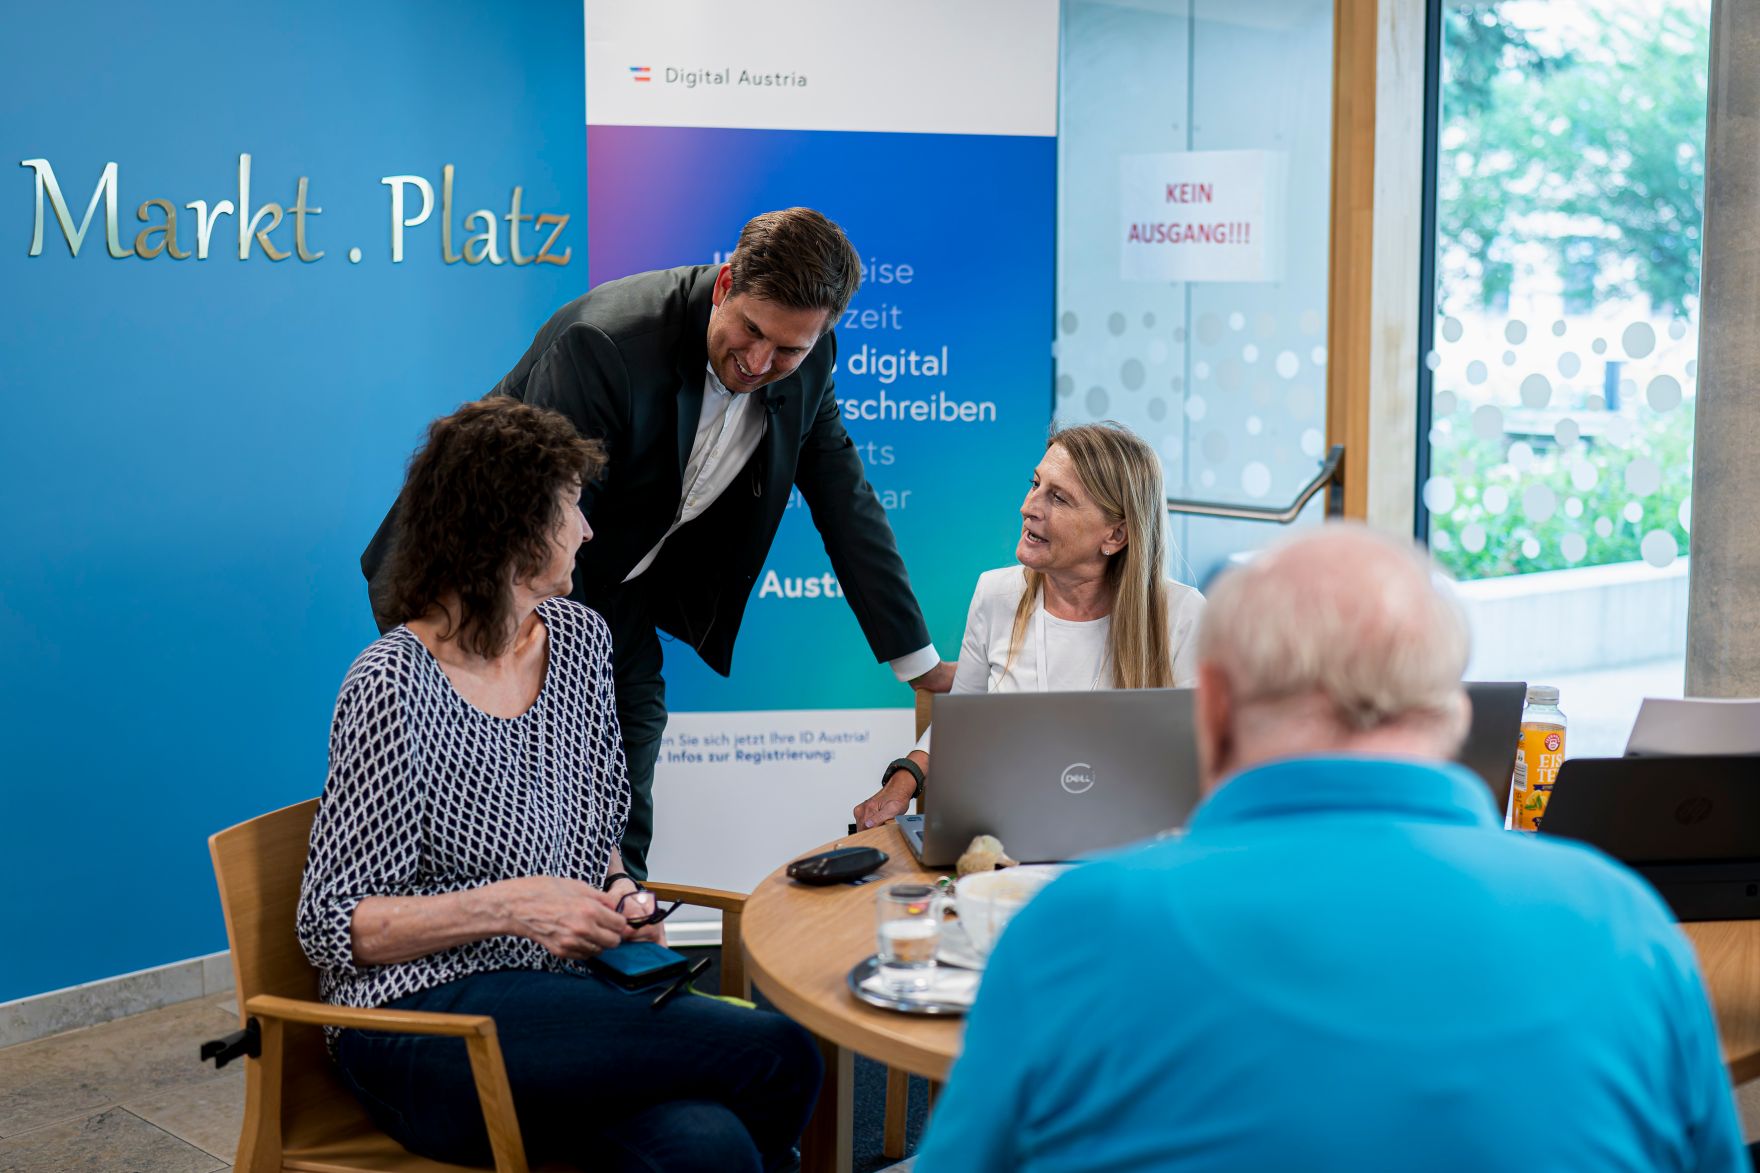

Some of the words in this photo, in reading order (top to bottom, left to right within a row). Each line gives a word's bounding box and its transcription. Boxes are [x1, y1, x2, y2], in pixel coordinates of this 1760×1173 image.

[665, 67, 730, 88] Digital
[738, 69, 808, 87] Austria
[1165, 183, 1213, 203] KEIN
[20, 153, 325, 263] Markt
[381, 163, 573, 267] Platz
[1127, 222, 1251, 244] AUSGANG!!!
[844, 303, 903, 330] zeit
[848, 344, 948, 384] digital
[836, 389, 997, 422] schreiben
[758, 569, 844, 599] Aust
[679, 733, 699, 746] Sie
[704, 733, 729, 745] sich
[734, 733, 764, 748] jetzt
[770, 731, 795, 744] Ihre
[799, 730, 815, 744] ID
[668, 750, 702, 763] Infos
[708, 751, 730, 762] zur
[1539, 754, 1562, 768] EIS
[1536, 768, 1559, 782] TE
